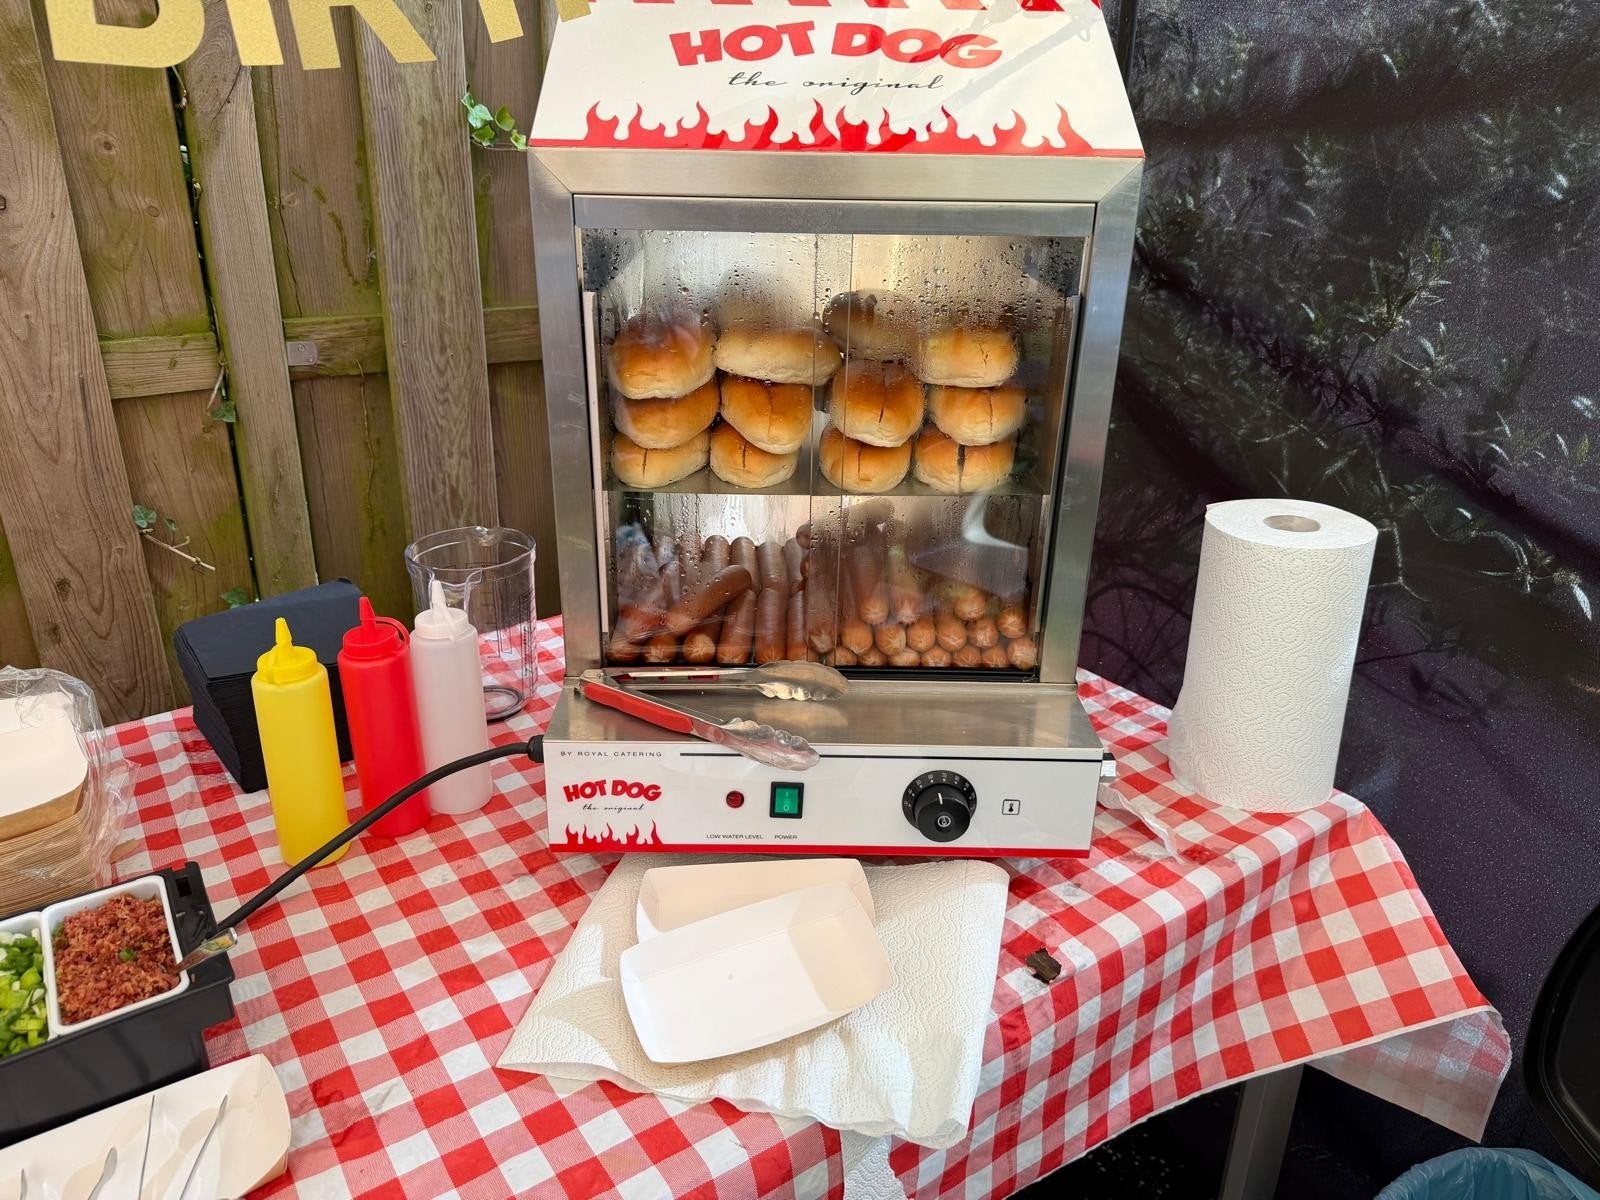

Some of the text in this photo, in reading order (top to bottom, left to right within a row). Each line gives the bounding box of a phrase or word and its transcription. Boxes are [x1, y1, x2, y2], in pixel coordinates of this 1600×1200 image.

[669, 21, 1002, 69] HOT DOG
[728, 71, 944, 96] the original
[563, 779, 662, 802] HOT DOG
[582, 803, 645, 813] the original
